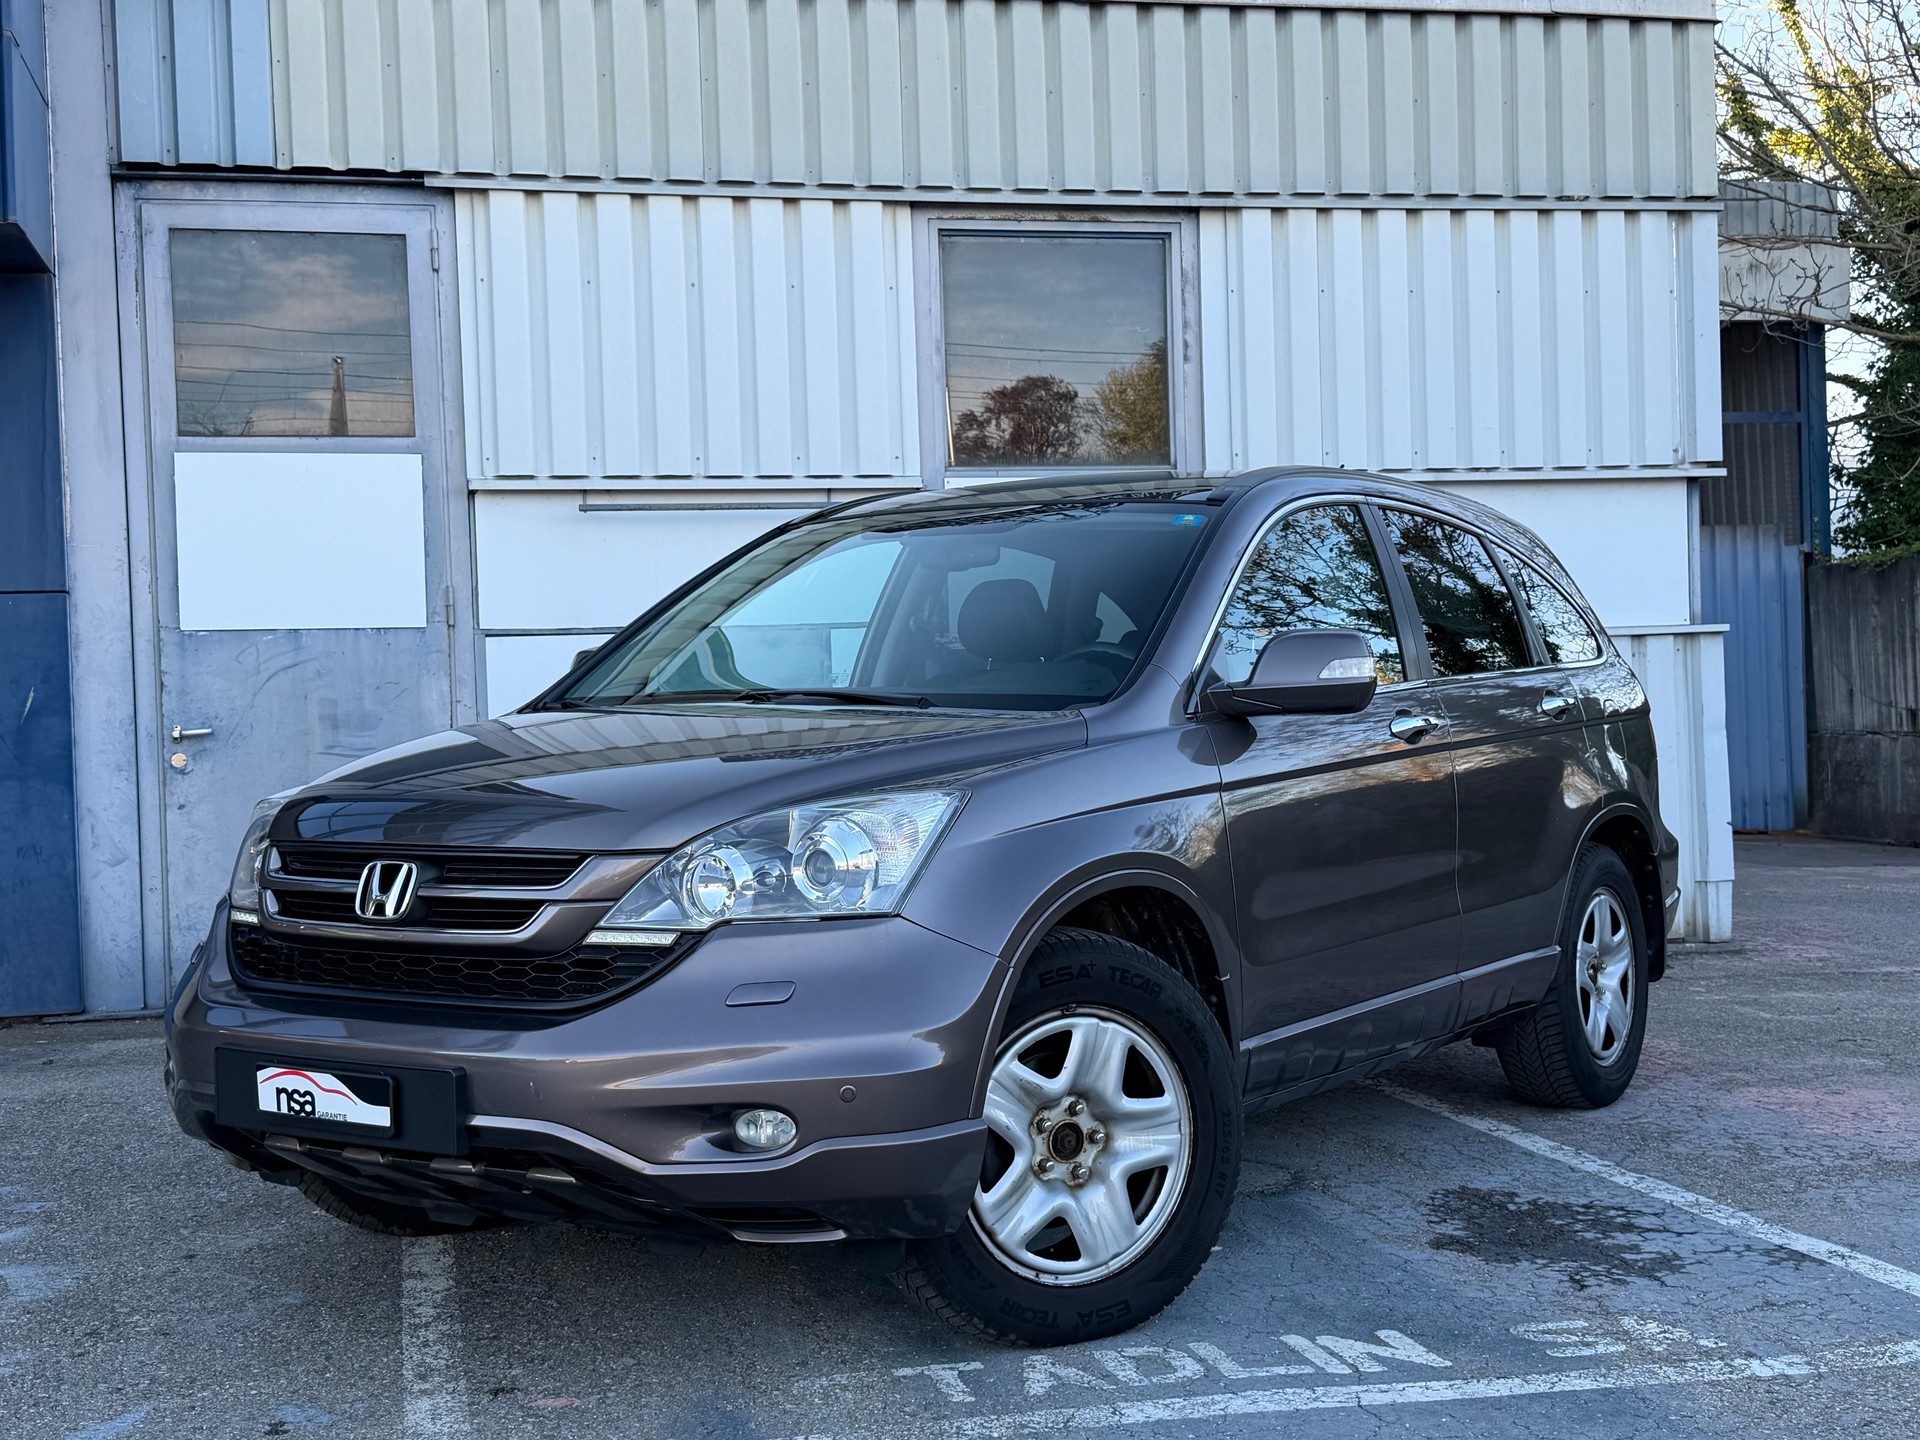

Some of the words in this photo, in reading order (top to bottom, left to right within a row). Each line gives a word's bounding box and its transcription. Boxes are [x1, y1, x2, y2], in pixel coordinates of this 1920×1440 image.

[1107, 965, 1164, 1000] TECAR
[275, 1086, 316, 1117] nsa
[316, 1110, 348, 1121] GARANTIE
[1219, 1109, 1234, 1165] 225/65
[1214, 1170, 1230, 1200] R17
[998, 1296, 1061, 1329] TECAR
